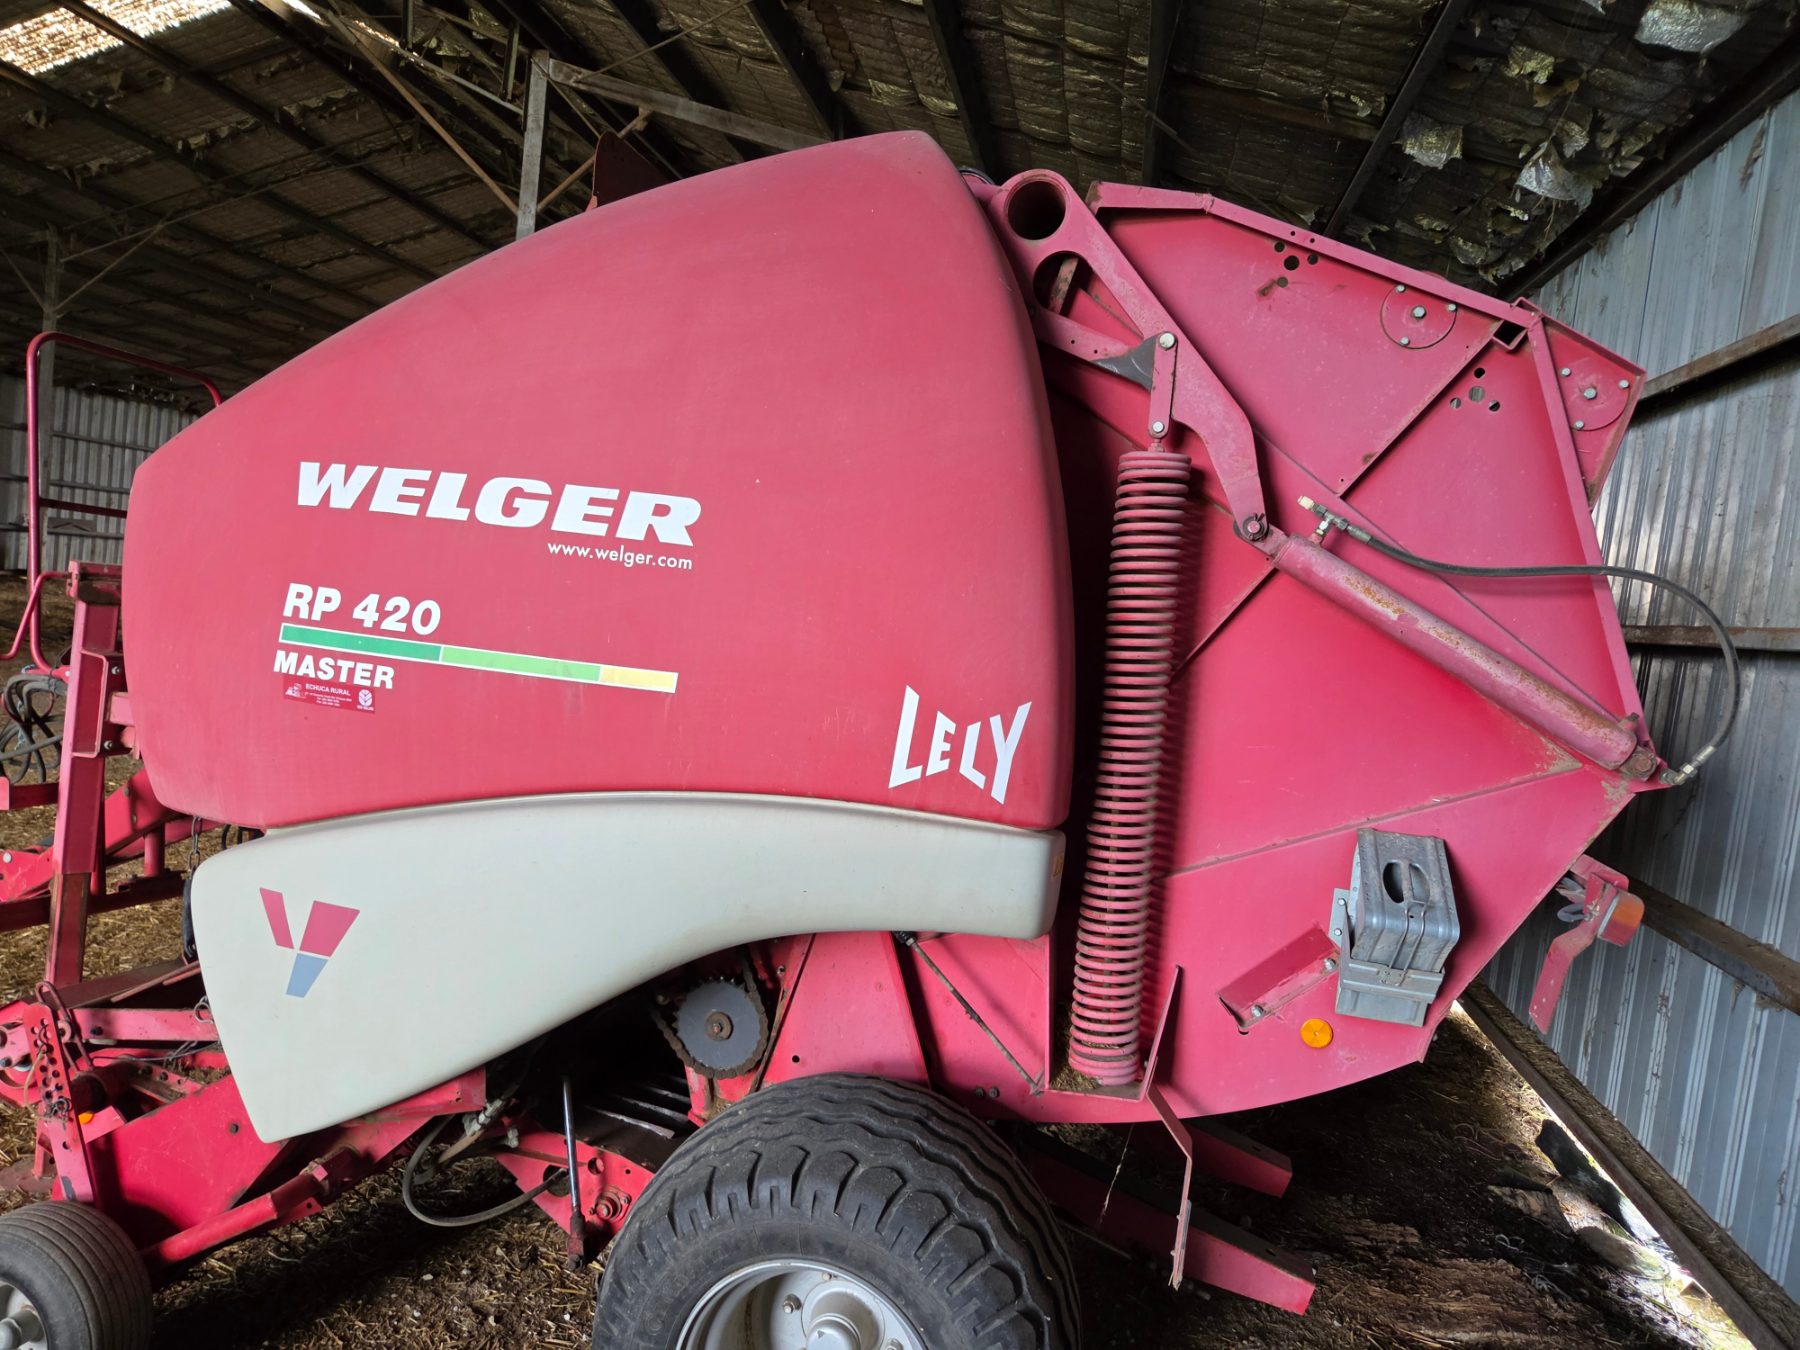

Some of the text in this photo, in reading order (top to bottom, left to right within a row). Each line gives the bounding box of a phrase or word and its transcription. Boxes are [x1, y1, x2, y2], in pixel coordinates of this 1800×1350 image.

[297, 461, 702, 546] WELGER
[547, 542, 693, 570] www.welger.com
[283, 582, 441, 636] RP 420
[273, 649, 395, 689] MASTER
[305, 683, 330, 693] ECHUCA
[330, 687, 351, 697] RURAL
[888, 684, 1033, 805] LELY
